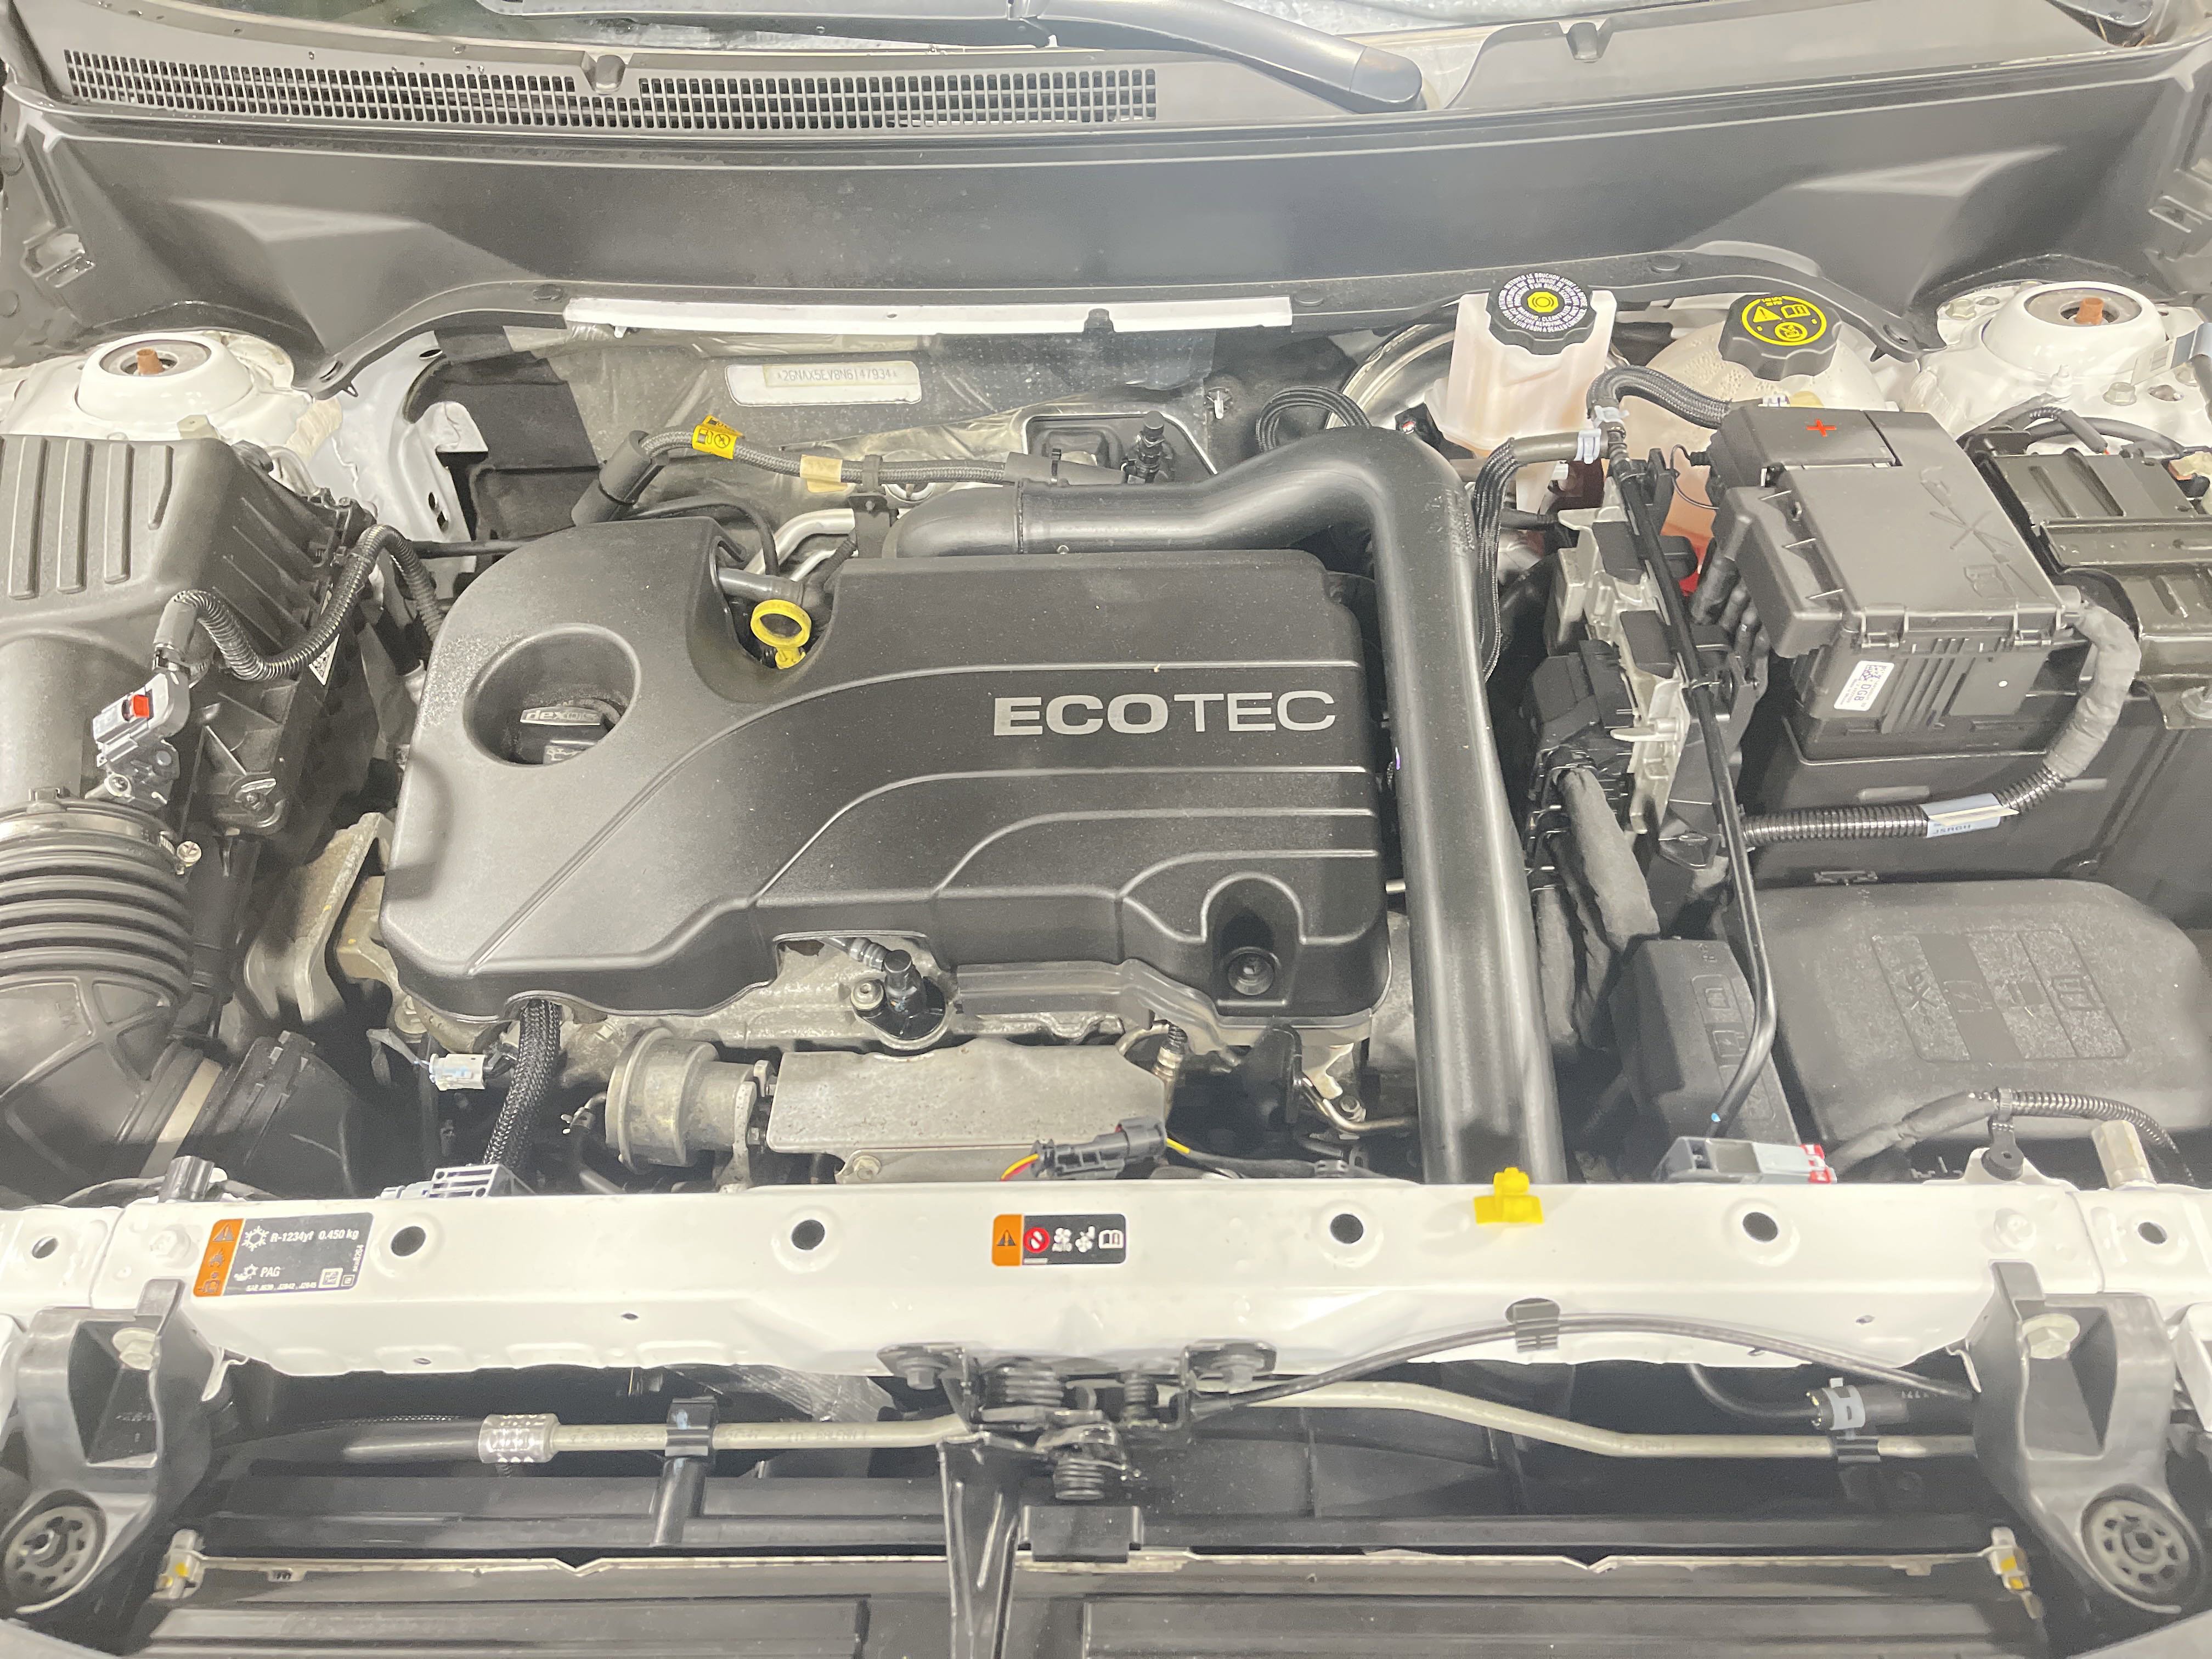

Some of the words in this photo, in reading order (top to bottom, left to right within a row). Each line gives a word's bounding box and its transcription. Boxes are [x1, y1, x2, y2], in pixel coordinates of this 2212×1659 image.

[1559, 276, 1577, 287] AVANT
[1510, 317, 1527, 328] FLUID
[1525, 324, 1542, 332] FROM
[1547, 324, 1569, 332] SEALED
[1854, 684, 1872, 701] DGB
[994, 690, 1335, 736] ECOTEC
[270, 1231, 314, 1243] R-1234yf
[318, 1229, 346, 1240] 0.450
[346, 1228, 359, 1240] kg
[260, 1266, 281, 1277] PAG
